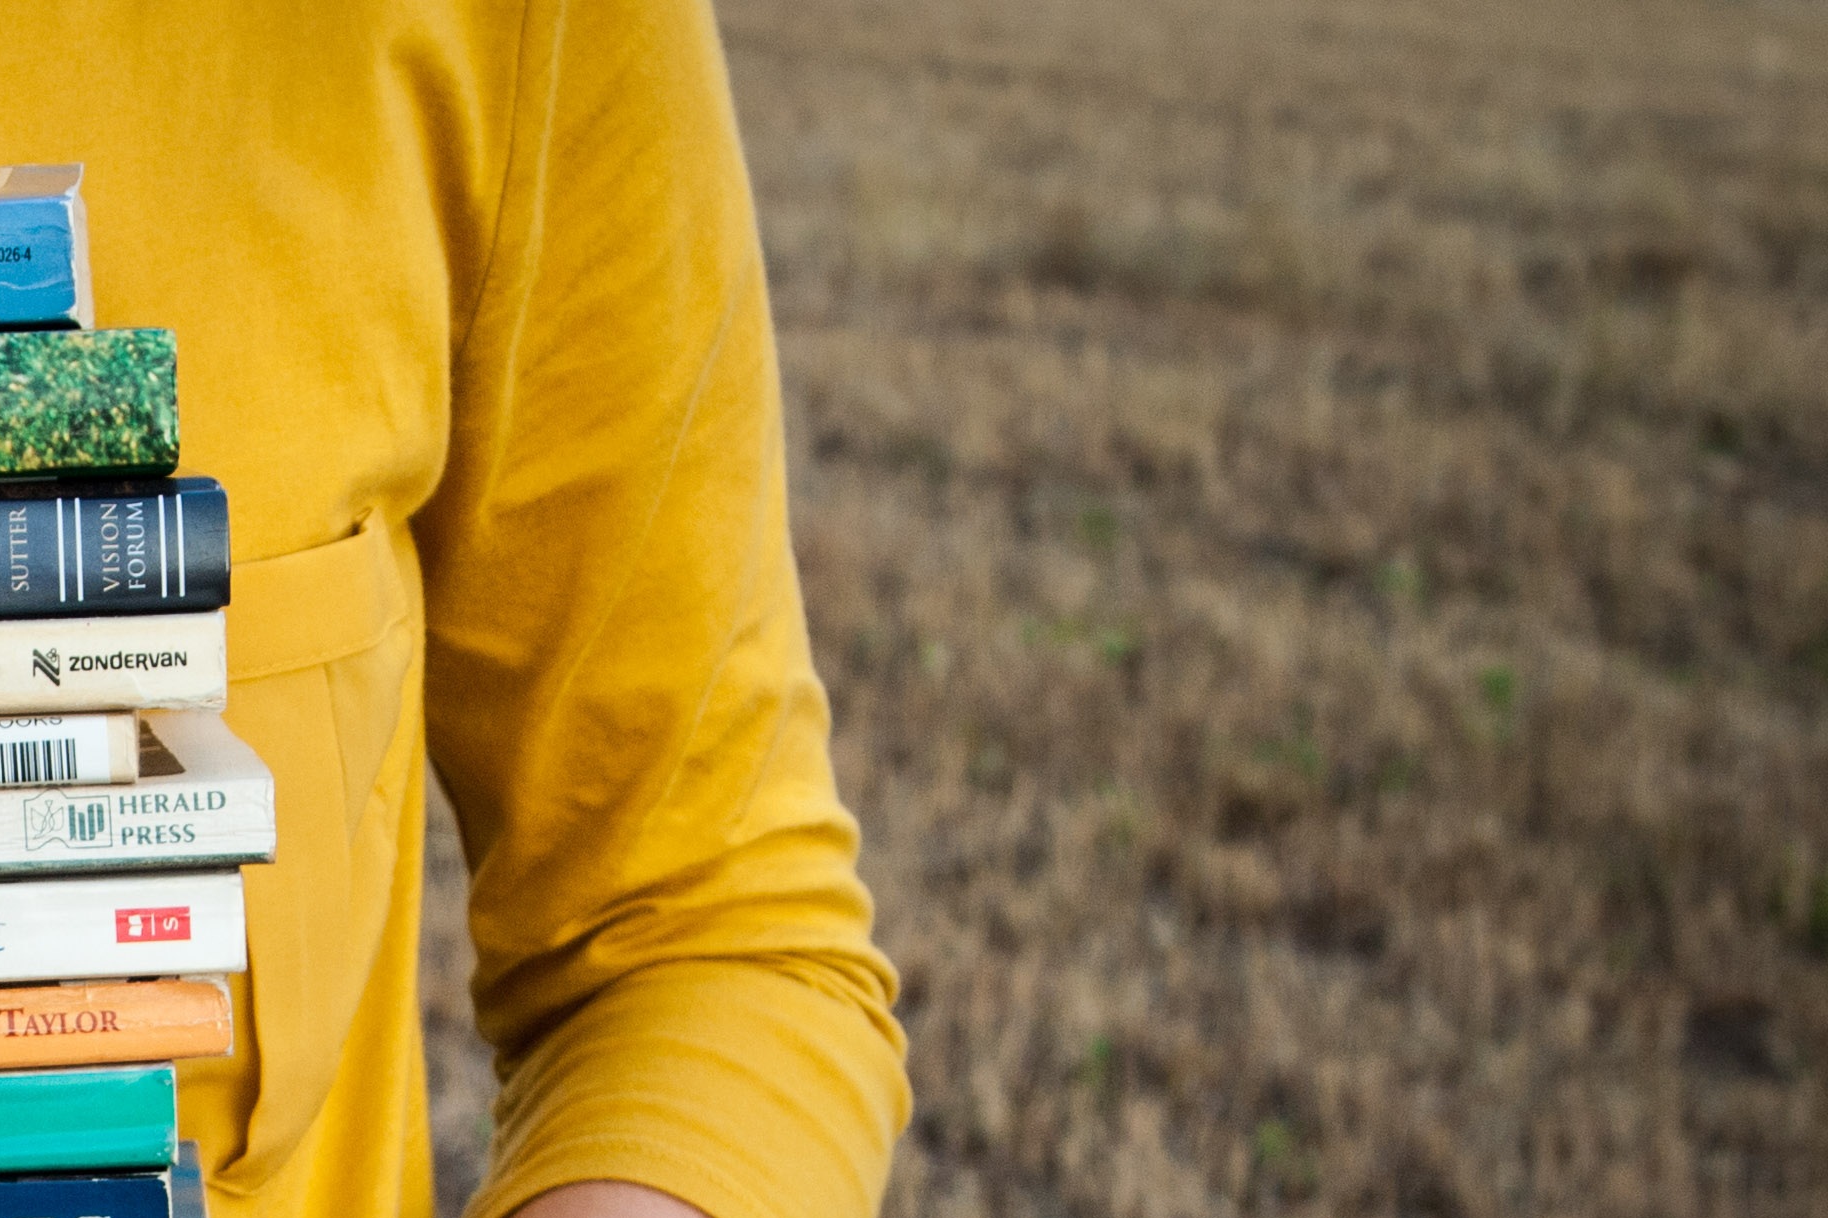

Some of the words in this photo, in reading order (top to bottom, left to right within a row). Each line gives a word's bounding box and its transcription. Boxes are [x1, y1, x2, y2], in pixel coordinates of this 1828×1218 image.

[10, 506, 29, 592] SUTTER
[102, 503, 121, 593] VISION
[128, 501, 145, 591] FORUM
[118, 790, 226, 816] HERALD
[121, 823, 196, 846] PRESS
